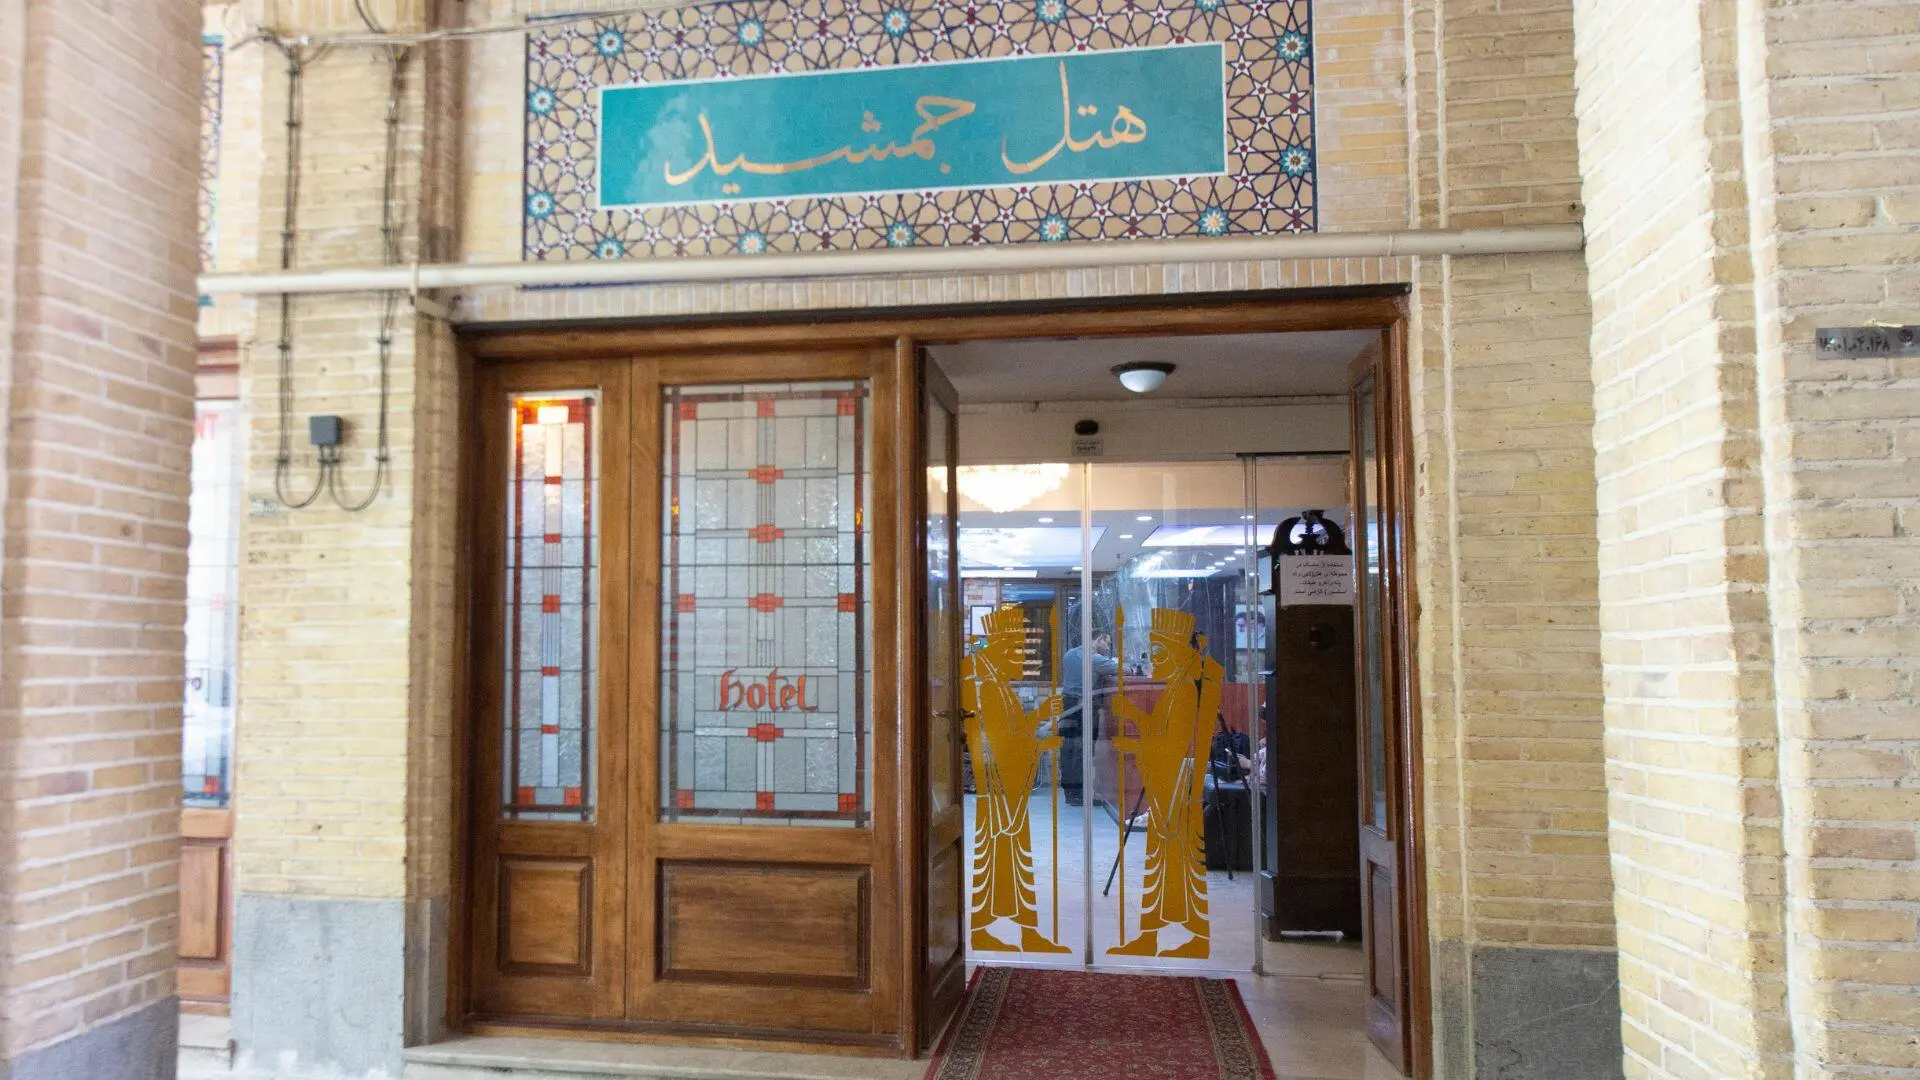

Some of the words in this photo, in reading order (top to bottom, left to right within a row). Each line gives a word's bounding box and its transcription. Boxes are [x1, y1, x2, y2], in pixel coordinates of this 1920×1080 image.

[663, 96, 975, 196] جمشید
[1003, 60, 1147, 173] هتل
[719, 665, 818, 712] hotel
